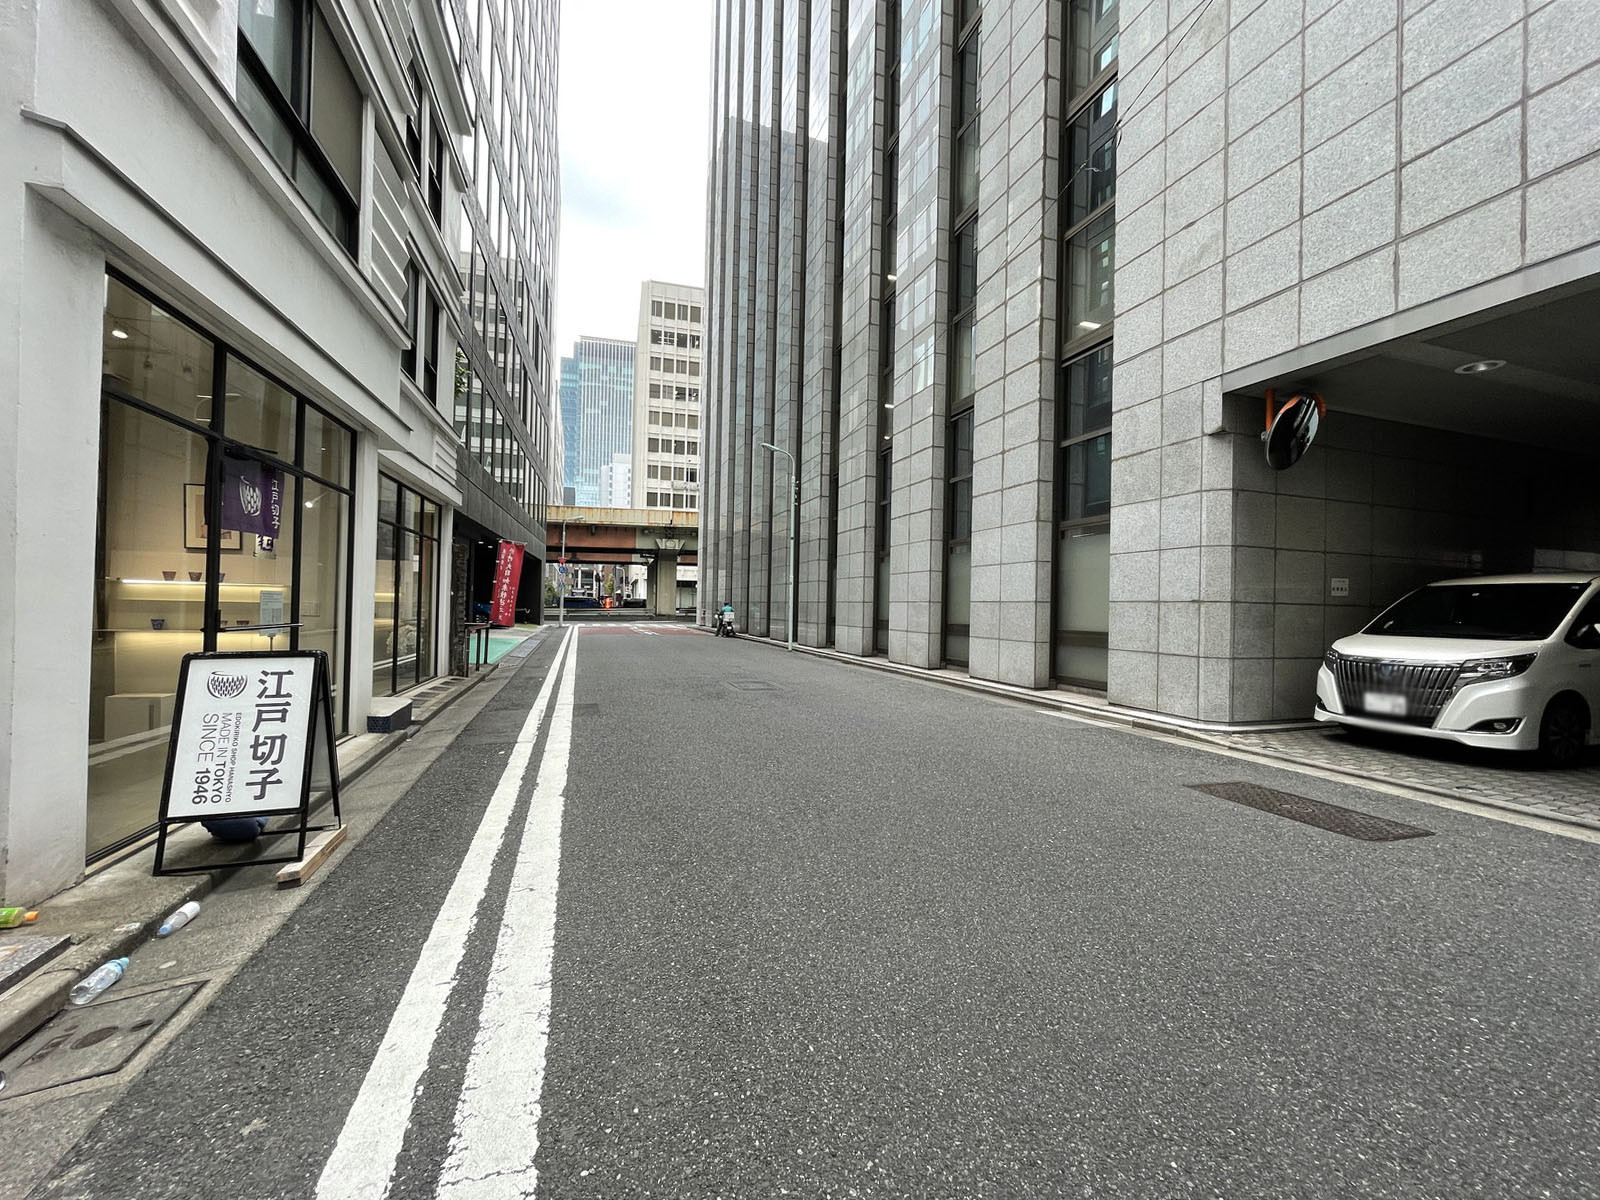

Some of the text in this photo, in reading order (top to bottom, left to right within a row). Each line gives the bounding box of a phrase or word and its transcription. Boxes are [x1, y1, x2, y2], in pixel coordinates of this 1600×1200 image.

[191, 713, 220, 805] SINCE 1946
[210, 712, 233, 804] MADE IN TOKYO
[225, 712, 242, 803] EDOKIRIKO SHOP HANASHYO
[245, 669, 294, 801] 江戸切子
